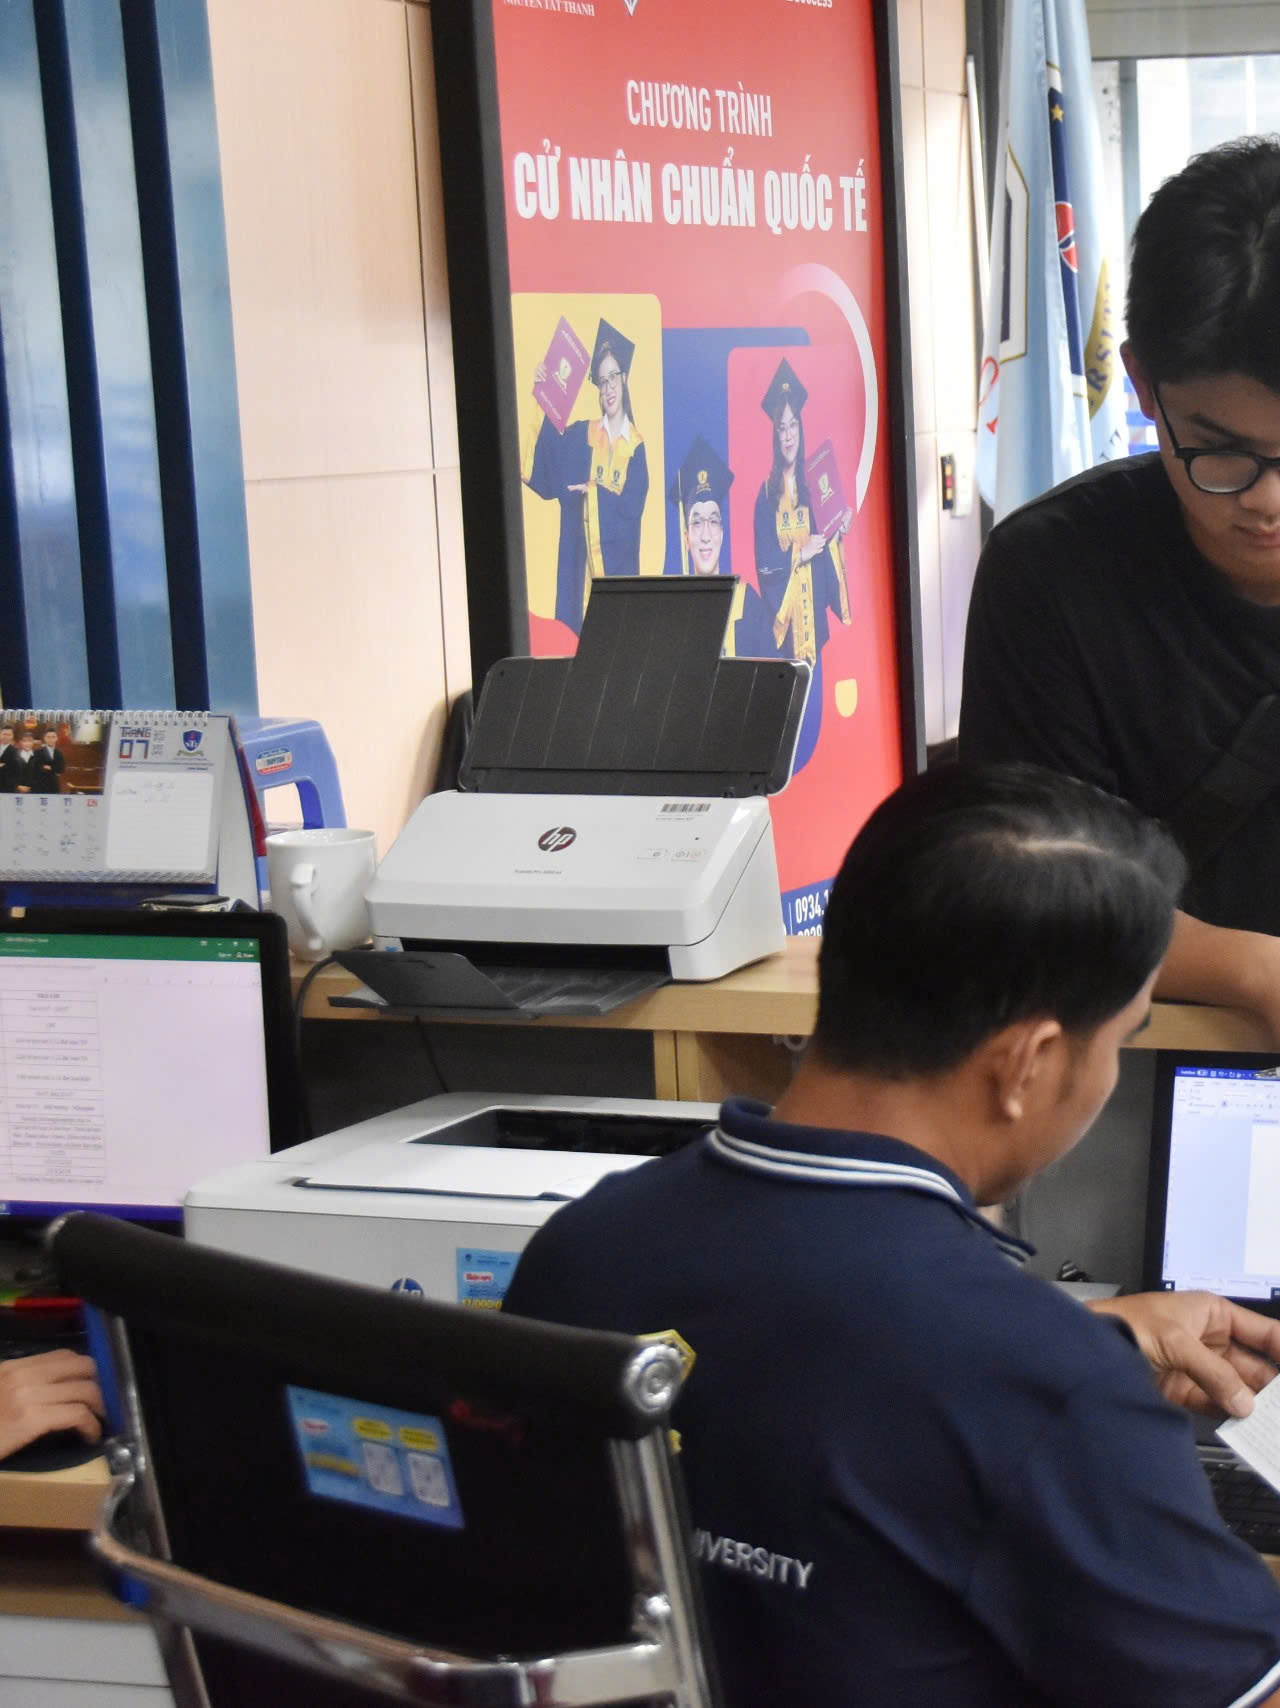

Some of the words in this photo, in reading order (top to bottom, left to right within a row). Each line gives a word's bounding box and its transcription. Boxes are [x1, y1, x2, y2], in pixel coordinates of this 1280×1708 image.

[626, 79, 711, 131] CHƯƠNG
[715, 81, 773, 137] TRÌNH
[513, 138, 561, 220] CỬ
[569, 148, 653, 223] NHÂN
[662, 146, 755, 227] CHUẨN
[763, 154, 832, 235] QUỐC
[840, 158, 868, 232] TẾ
[119, 739, 149, 760] 07
